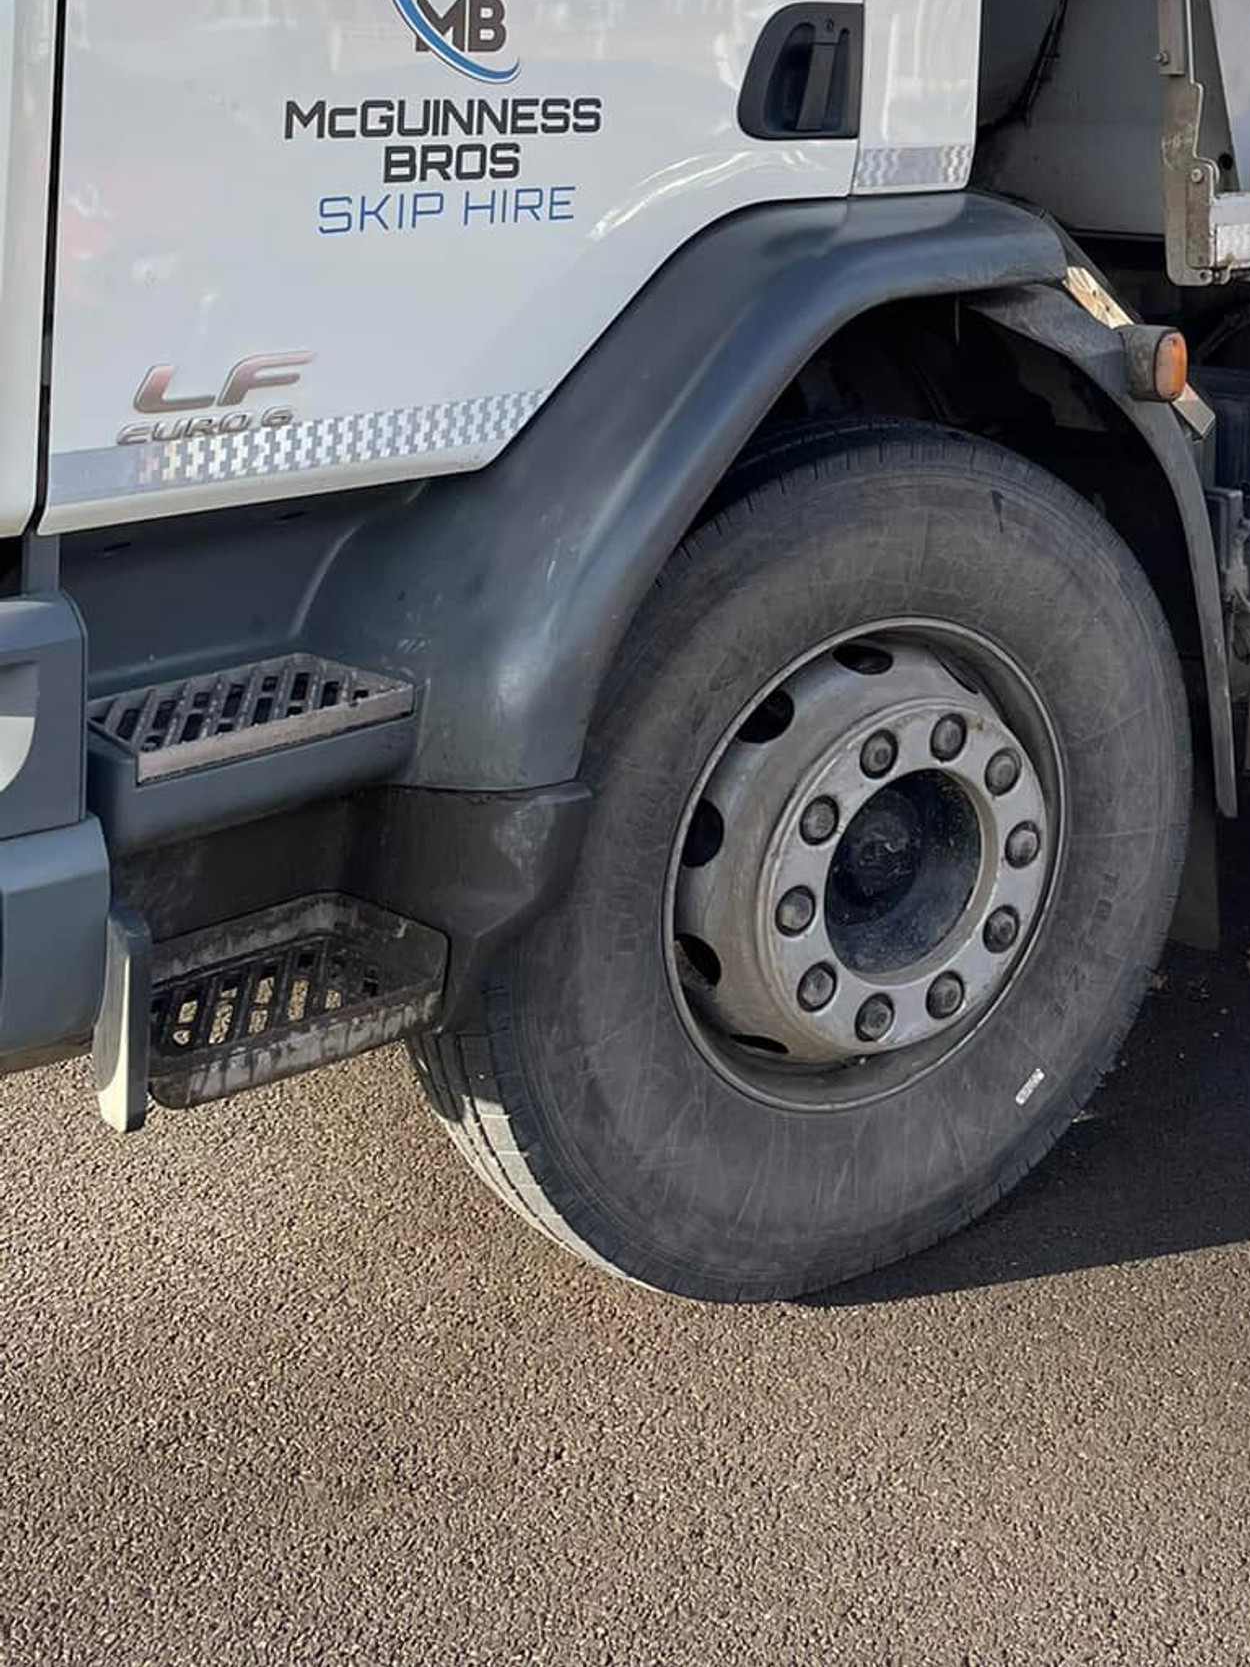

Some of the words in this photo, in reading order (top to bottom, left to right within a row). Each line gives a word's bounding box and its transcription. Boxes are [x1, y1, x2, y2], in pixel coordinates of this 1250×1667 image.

[285, 98, 602, 139] McGUINNESS
[384, 143, 520, 184] BROS
[318, 192, 444, 234] SKIP
[463, 186, 576, 226] HIRE
[133, 351, 313, 413] LF
[117, 412, 251, 446] EURO
[261, 405, 293, 428] 6
